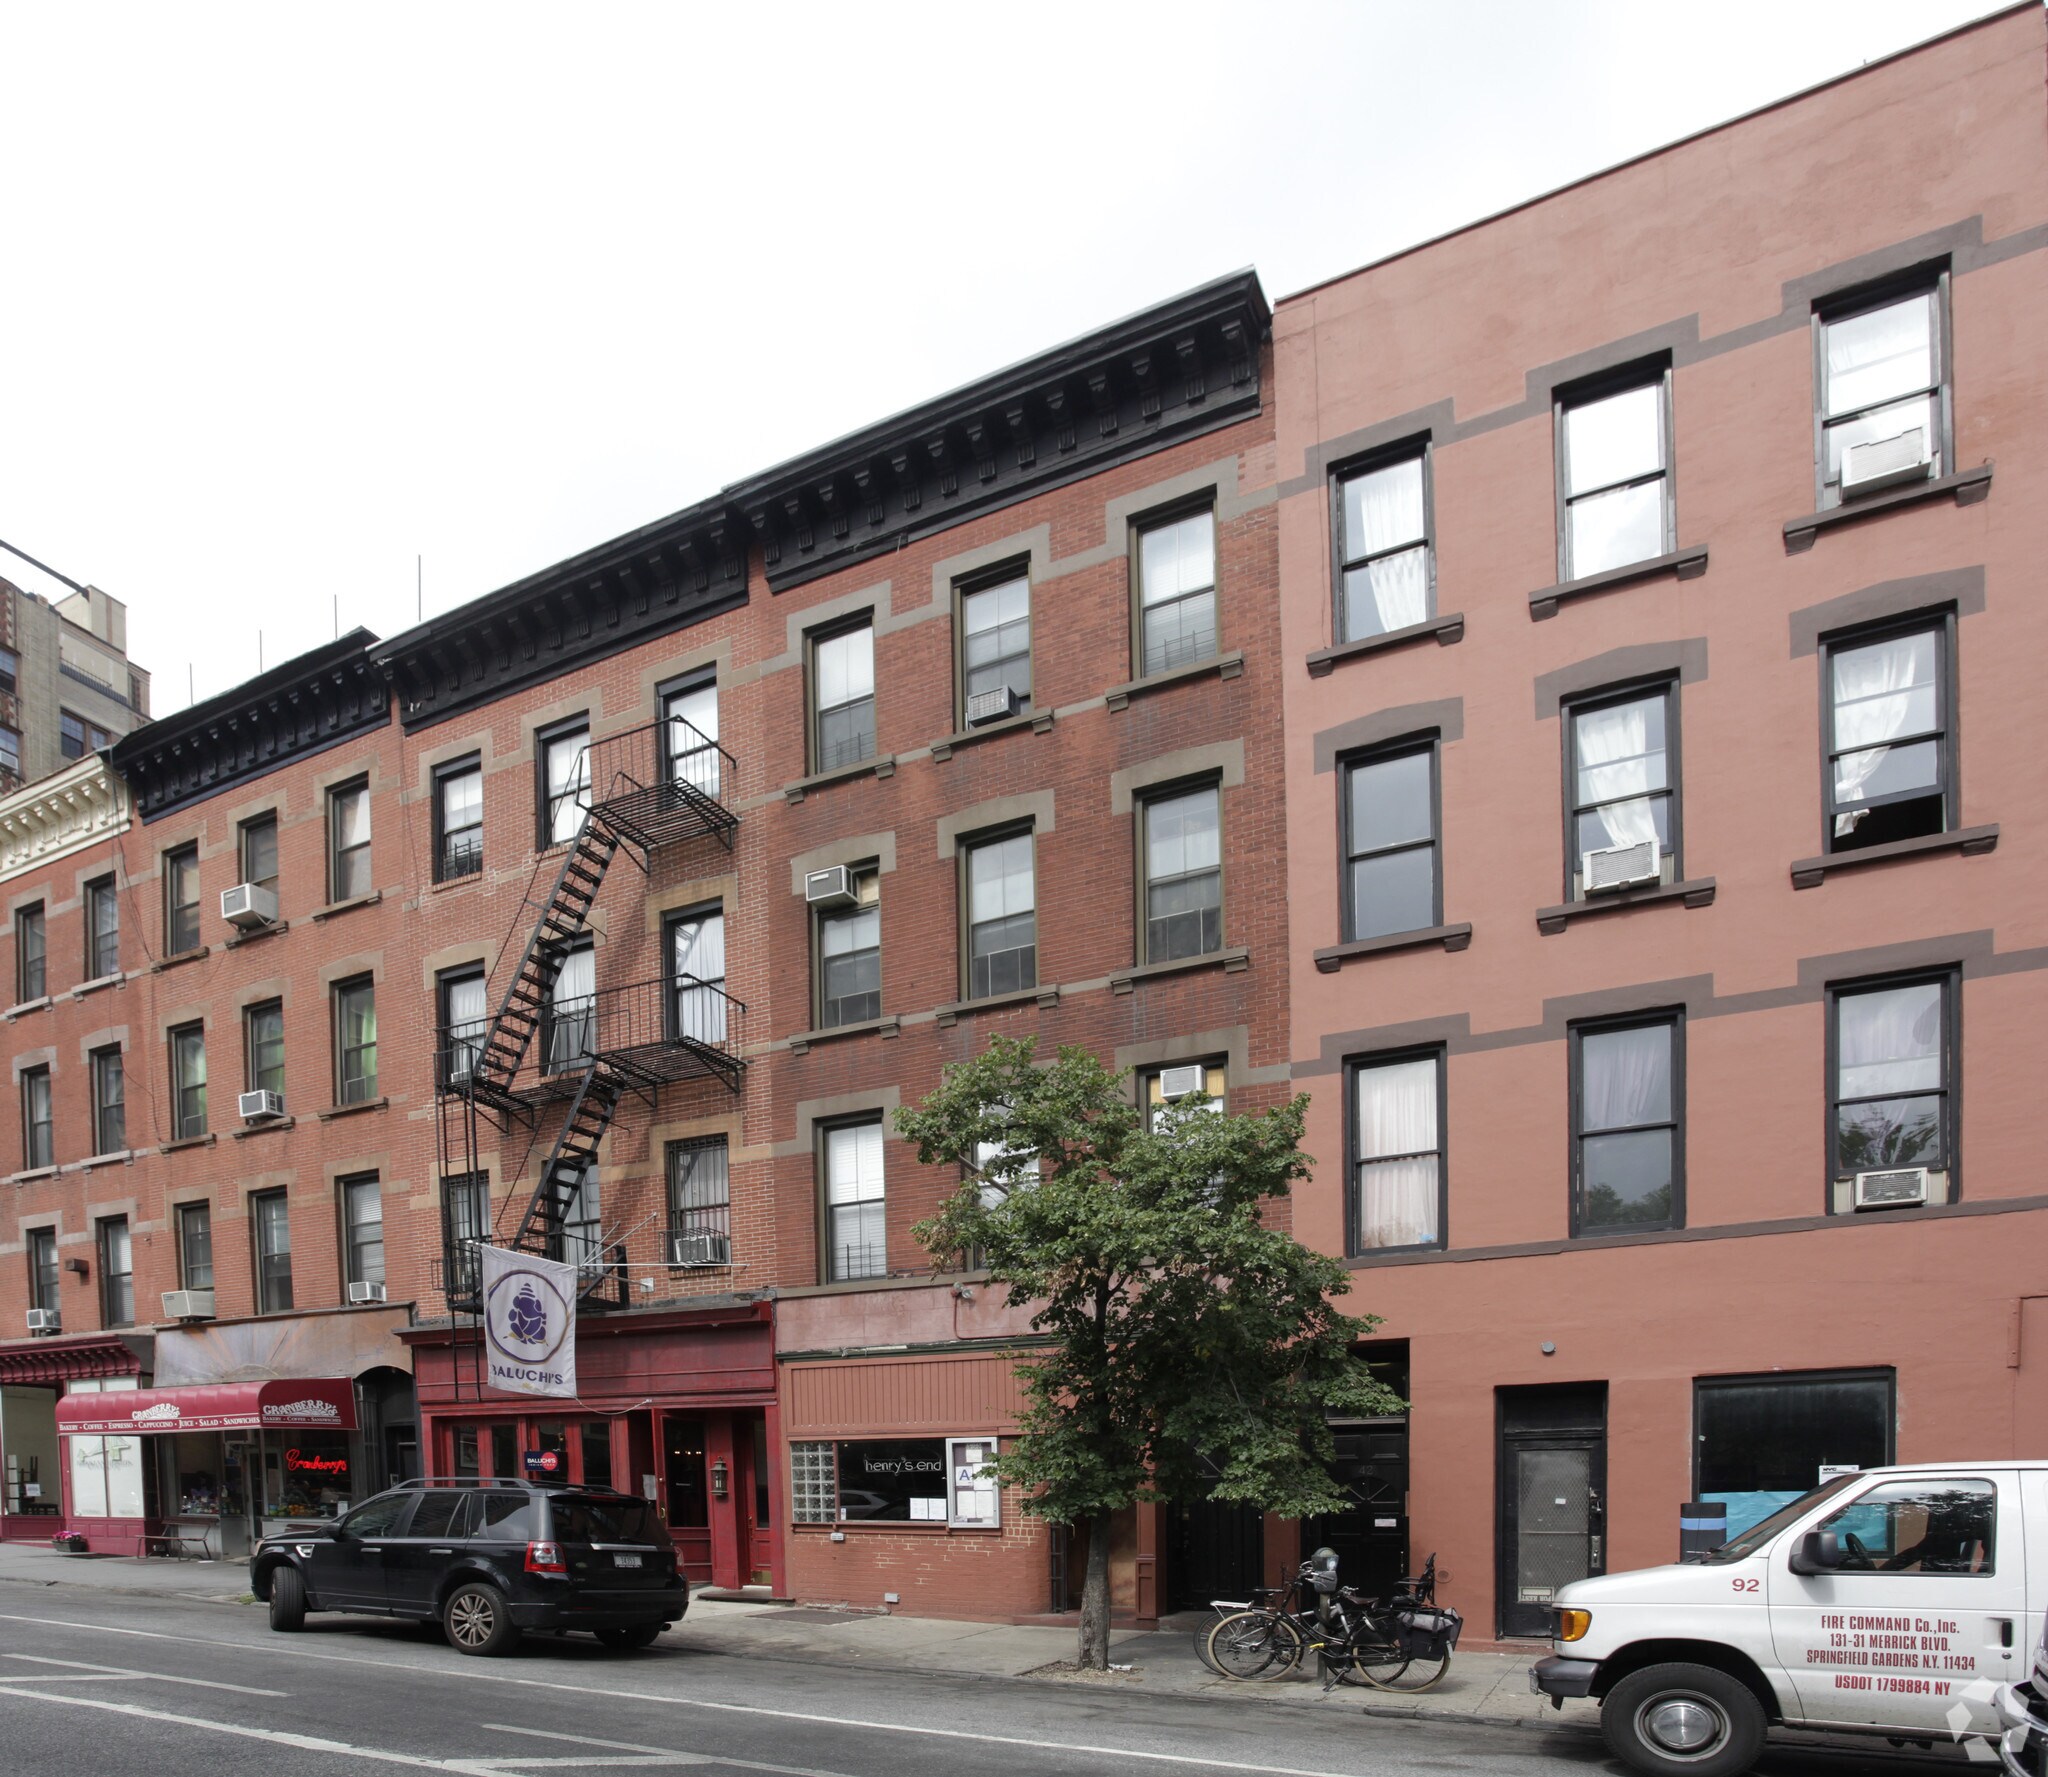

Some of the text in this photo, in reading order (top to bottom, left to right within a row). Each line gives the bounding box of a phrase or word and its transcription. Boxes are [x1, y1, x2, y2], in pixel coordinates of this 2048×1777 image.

[262, 1399, 338, 1416] CRANBERRY'S
[179, 1419, 194, 1428] JUICE
[199, 1417, 219, 1426] SALAD
[223, 1416, 260, 1425] SANDWICHES
[865, 1457, 942, 1476] henry's end
[959, 1469, 970, 1481] A
[1732, 1578, 1760, 1592] 92
[1821, 1615, 1845, 1629] FIRE
[1849, 1616, 1910, 1632] COMMAND
[1830, 1633, 1951, 1651] 131-31 MERRICK BLVD.
[1807, 1650, 1975, 1670] SPRINGFIELD GARDENS N.Y. 11434
[1835, 1675, 1951, 1696] USDOT 1799884 NY
